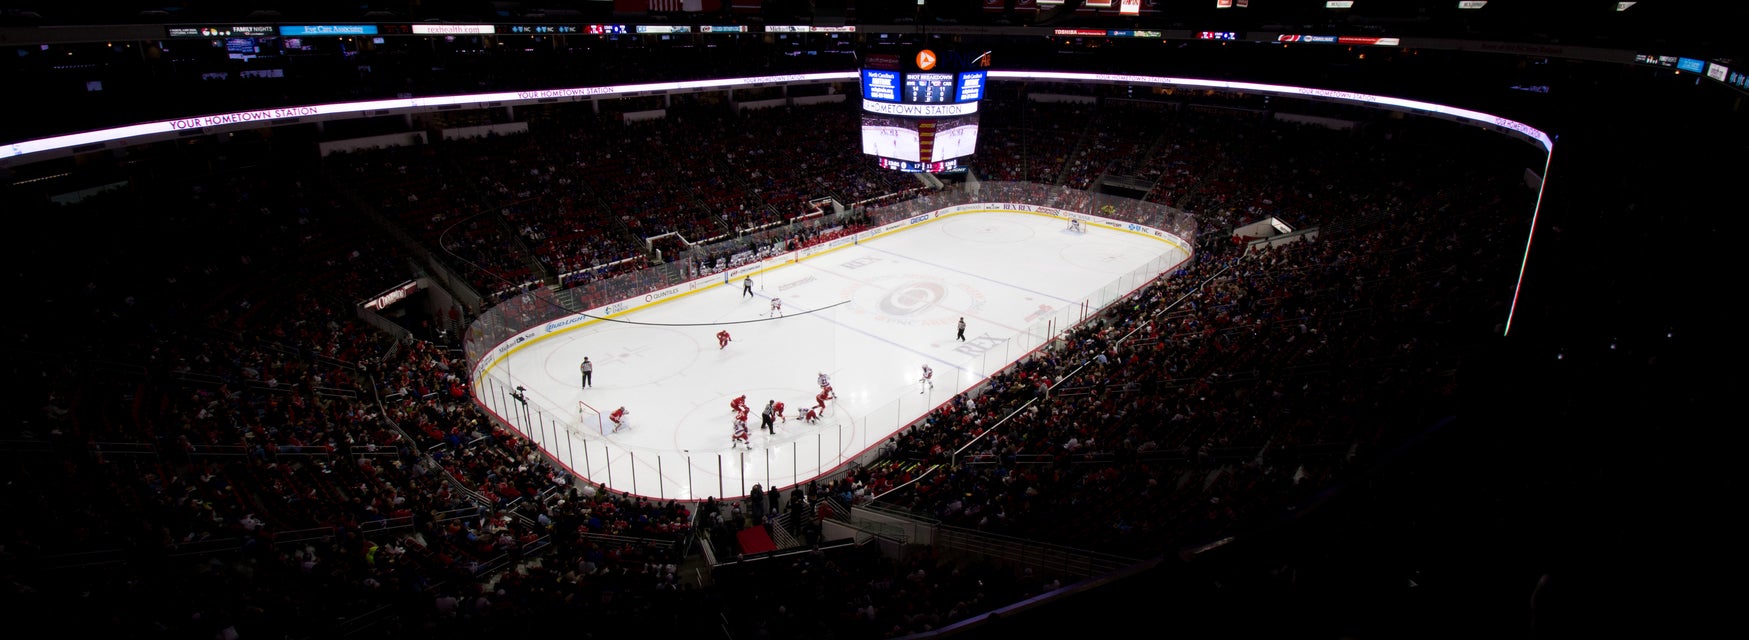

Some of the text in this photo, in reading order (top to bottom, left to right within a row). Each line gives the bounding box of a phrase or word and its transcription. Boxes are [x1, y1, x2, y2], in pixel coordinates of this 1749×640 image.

[517, 87, 614, 99] YOUR HOMETOWN STATION
[871, 103, 962, 114] HOMETOWN STATION
[170, 106, 318, 129] YOUR HOMETOWN STATION
[910, 215, 928, 224] GEICO
[840, 257, 882, 269] REX
[654, 288, 679, 299] QUINTILES
[545, 315, 586, 332] BUD LIGHT
[499, 338, 516, 353] Michael
[952, 332, 1010, 356] REX
